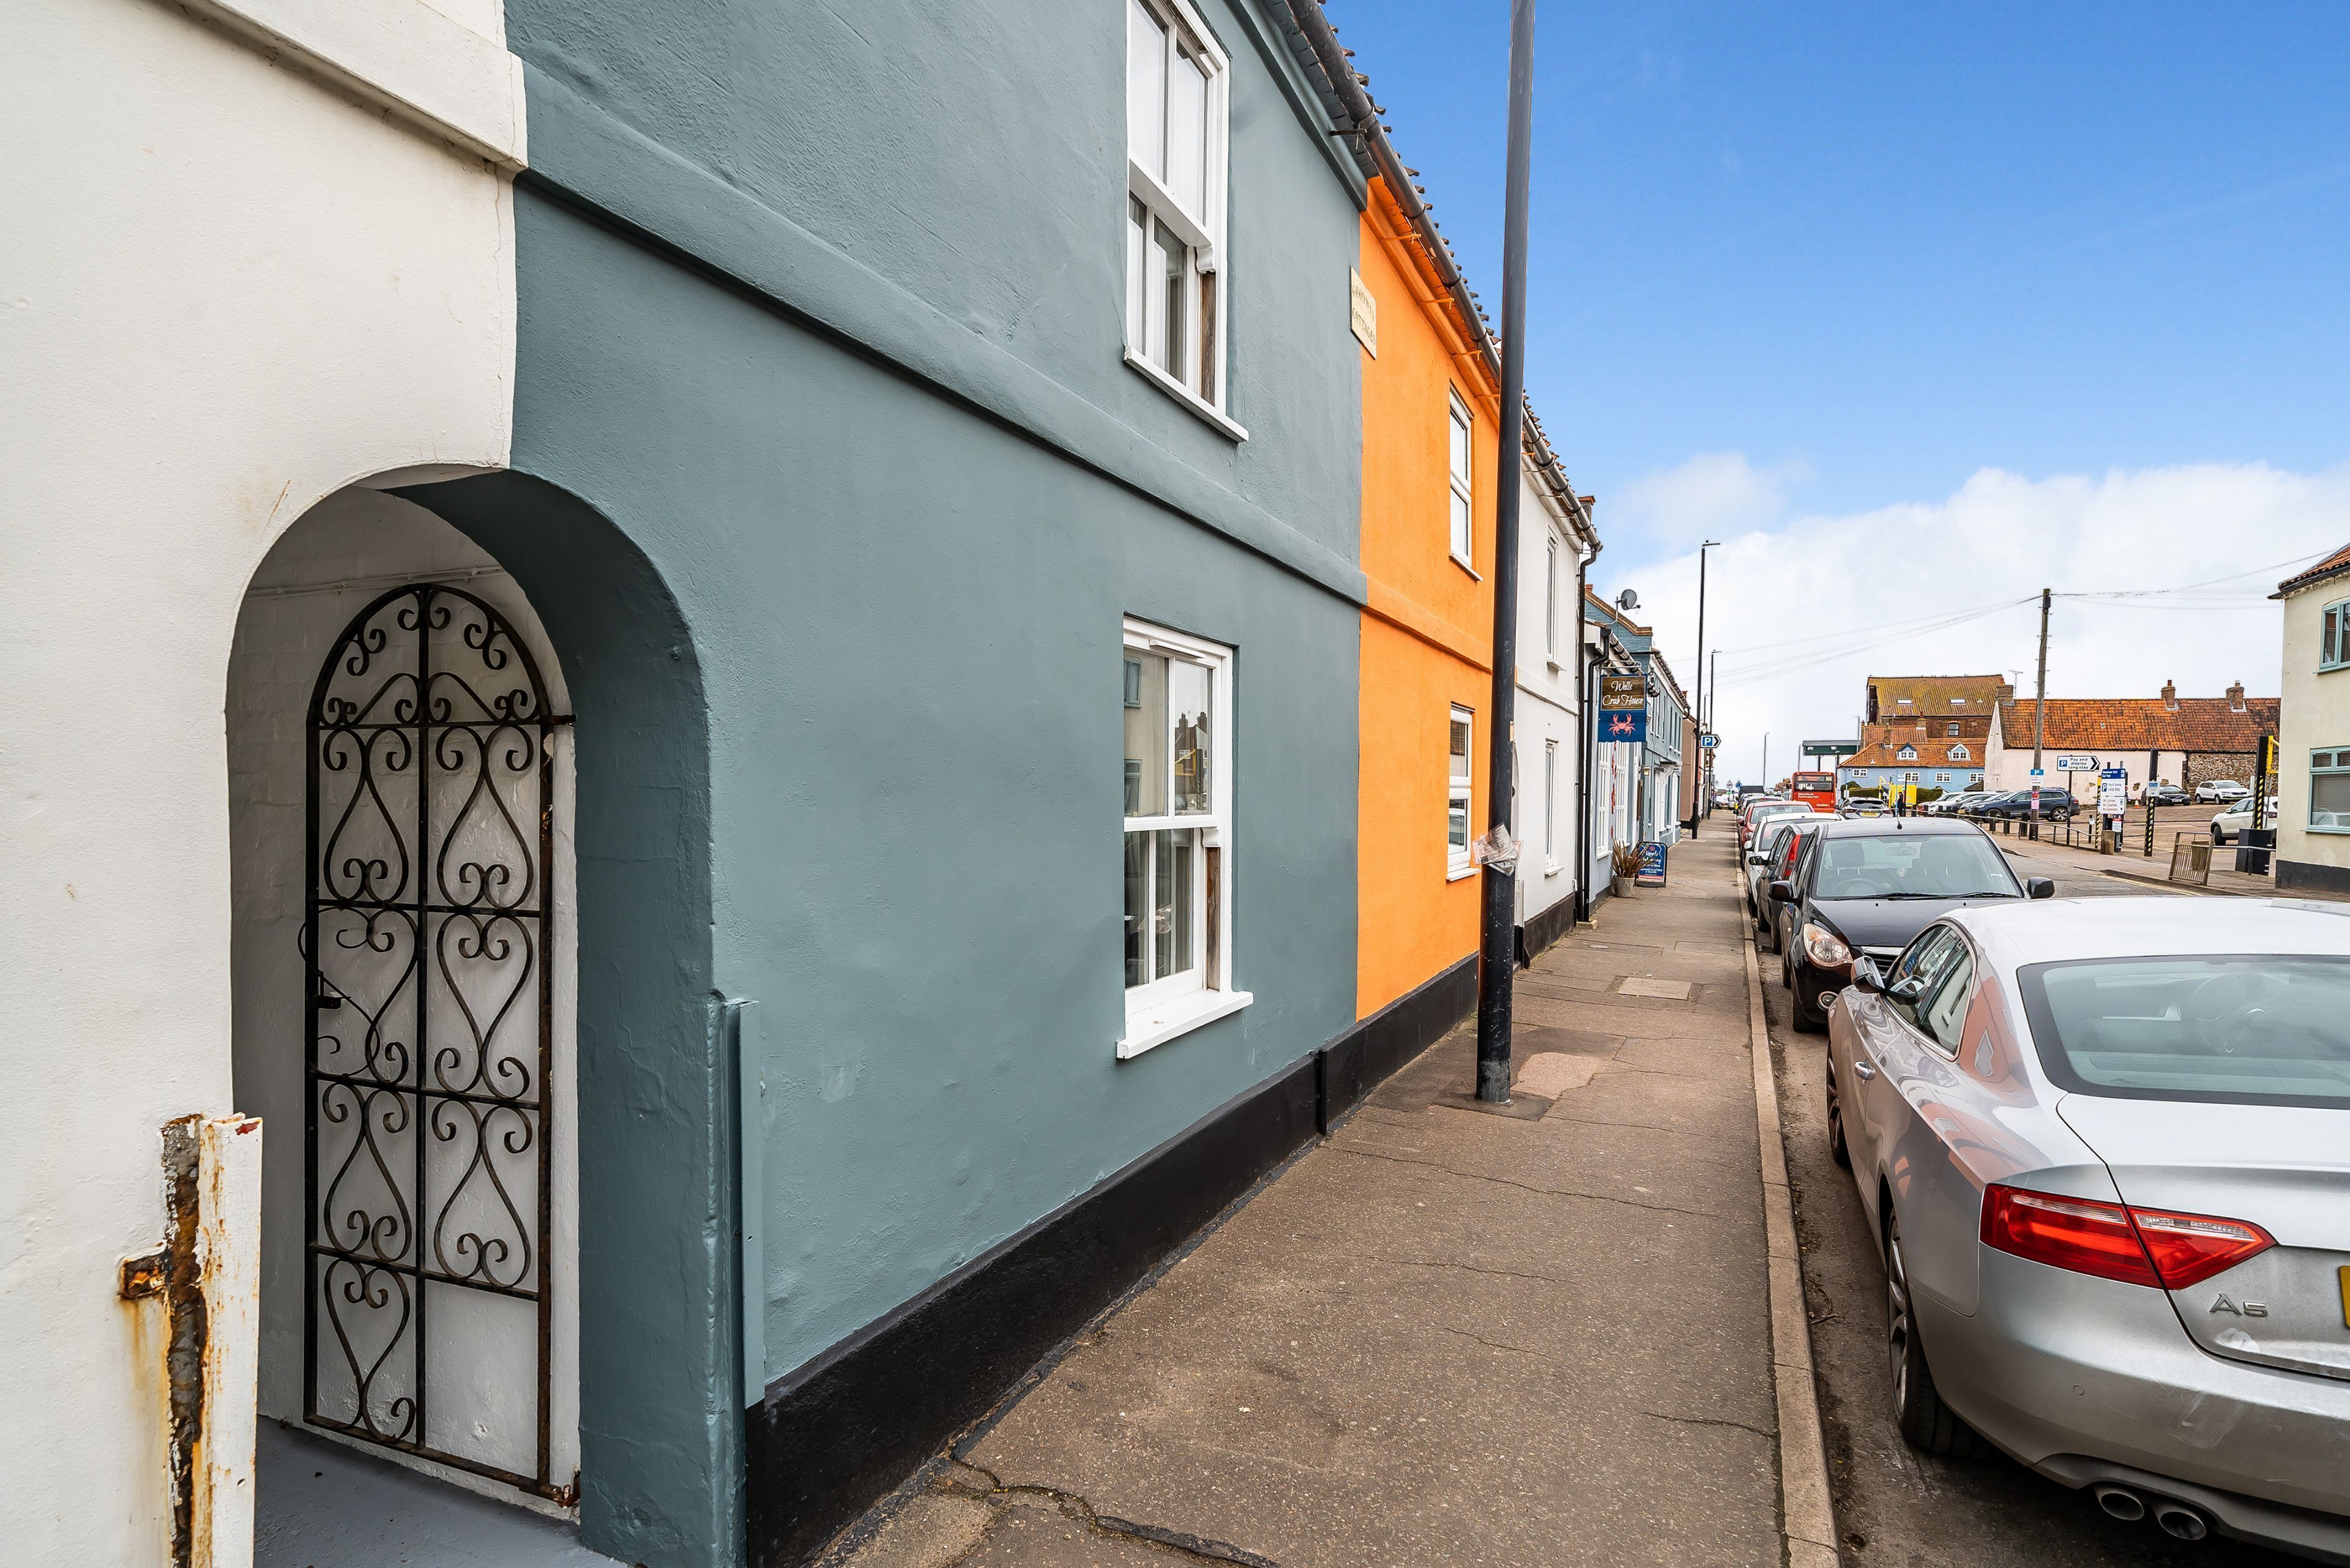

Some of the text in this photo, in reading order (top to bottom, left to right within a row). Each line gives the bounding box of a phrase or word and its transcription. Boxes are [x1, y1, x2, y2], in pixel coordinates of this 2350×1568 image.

[1352, 307, 1376, 346] COTTAGES
[1611, 681, 1633, 692] Wells
[1602, 694, 1644, 706] Crab House
[2209, 1293, 2268, 1317] A5
